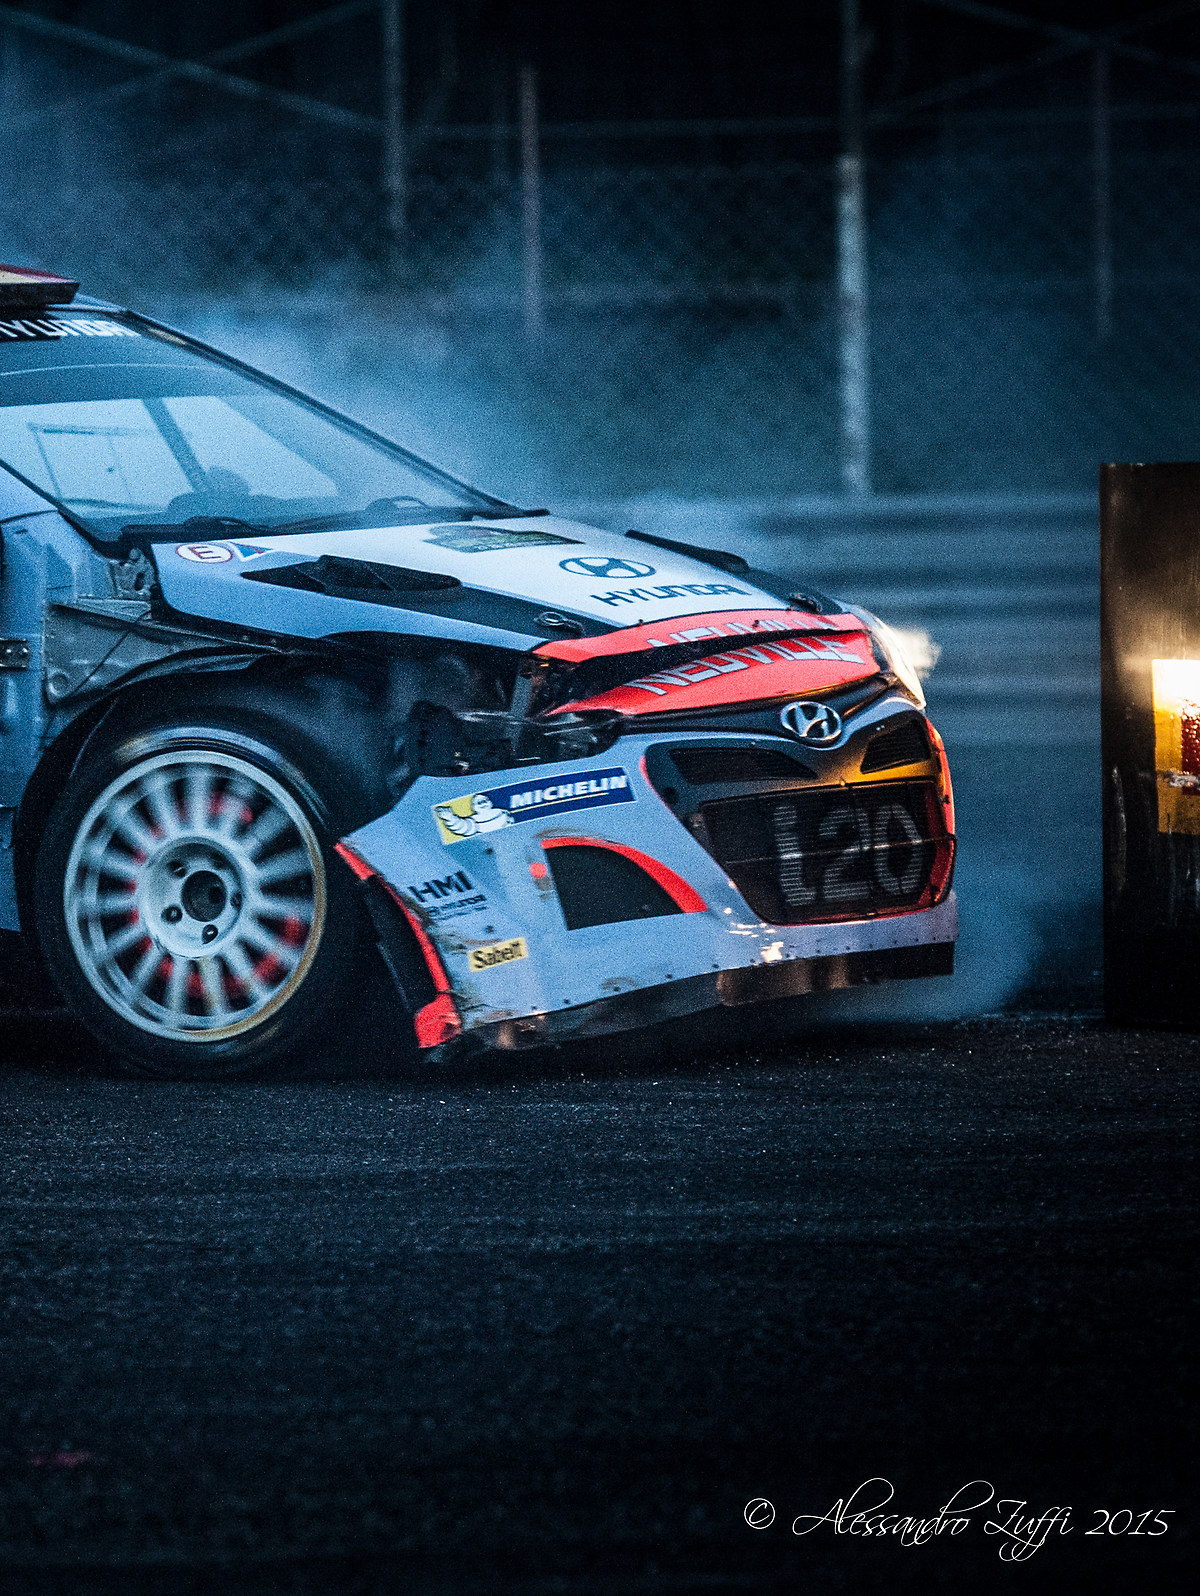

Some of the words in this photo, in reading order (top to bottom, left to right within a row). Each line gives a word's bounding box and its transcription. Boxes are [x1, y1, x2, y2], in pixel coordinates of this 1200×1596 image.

[590, 583, 752, 607] HYUNDAI
[509, 775, 628, 809] MICHELIN
[407, 870, 475, 902] HMI
